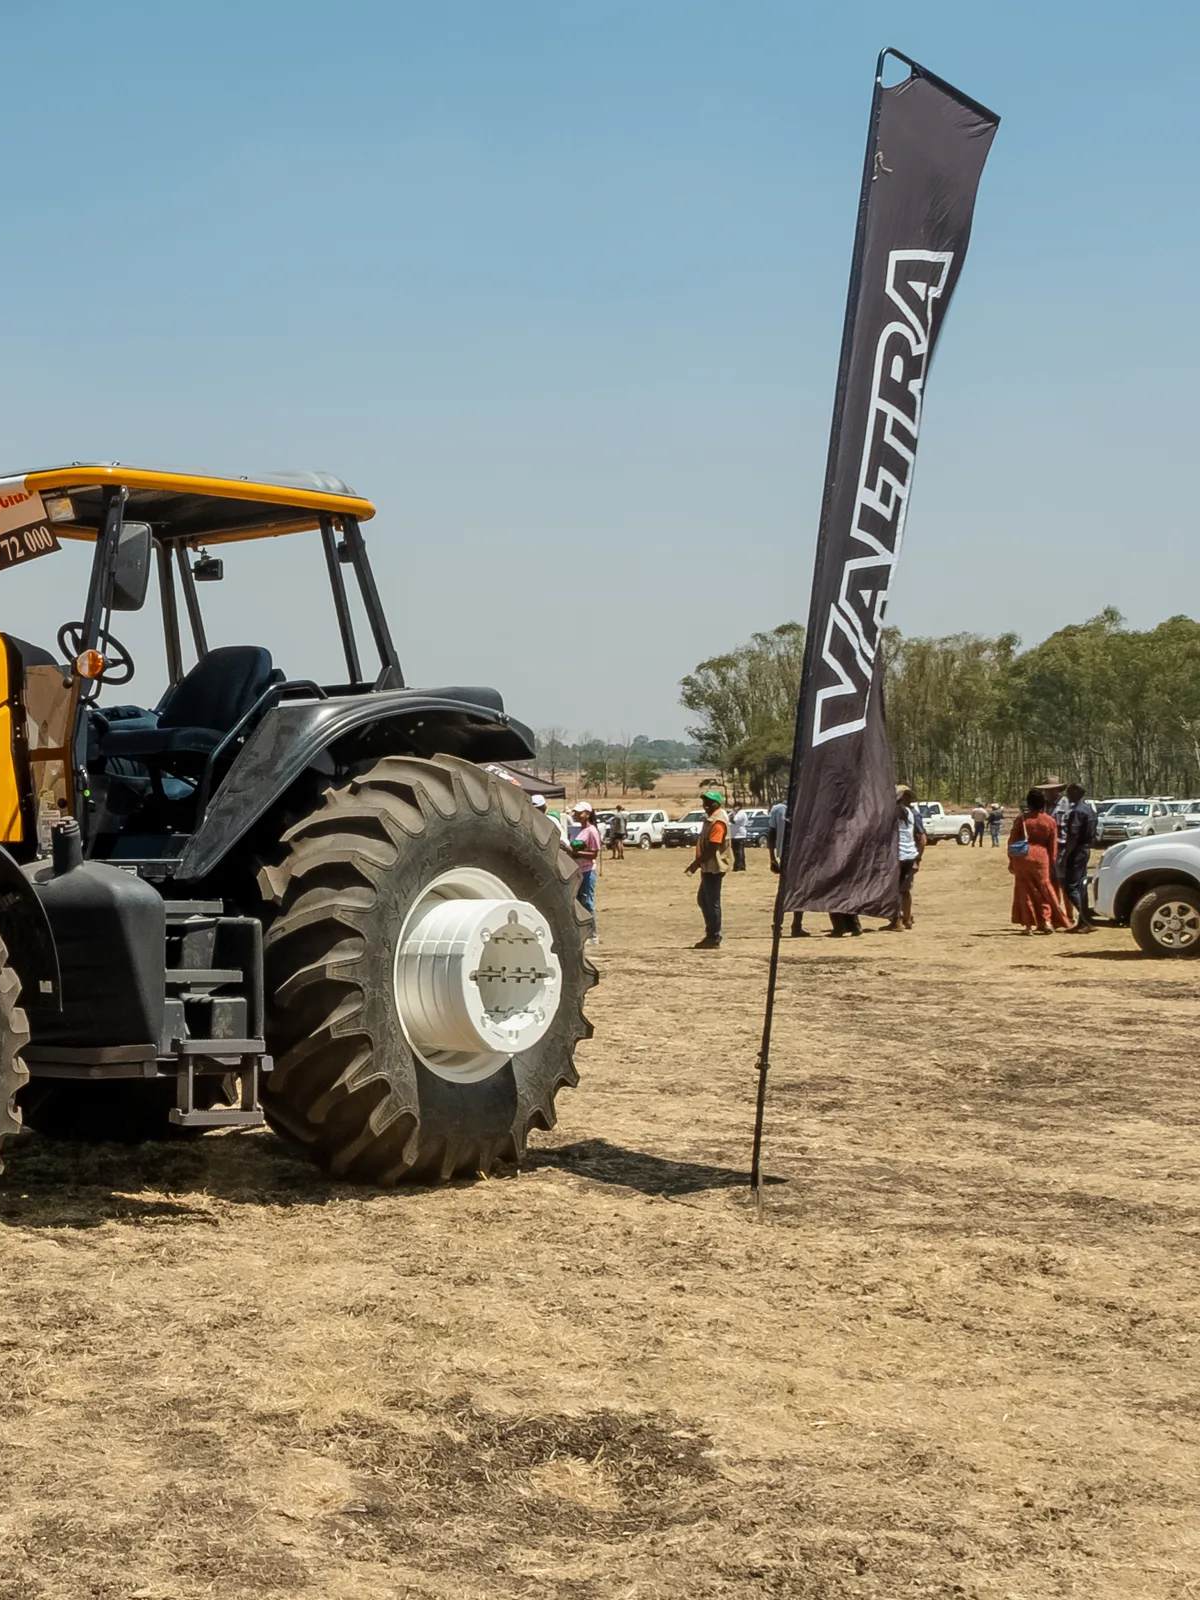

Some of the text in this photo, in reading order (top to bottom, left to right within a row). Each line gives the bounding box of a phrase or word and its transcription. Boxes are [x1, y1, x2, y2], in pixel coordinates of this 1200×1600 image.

[0, 536, 25, 562] 72
[24, 526, 53, 552] 000
[811, 248, 954, 748] VALTRA
